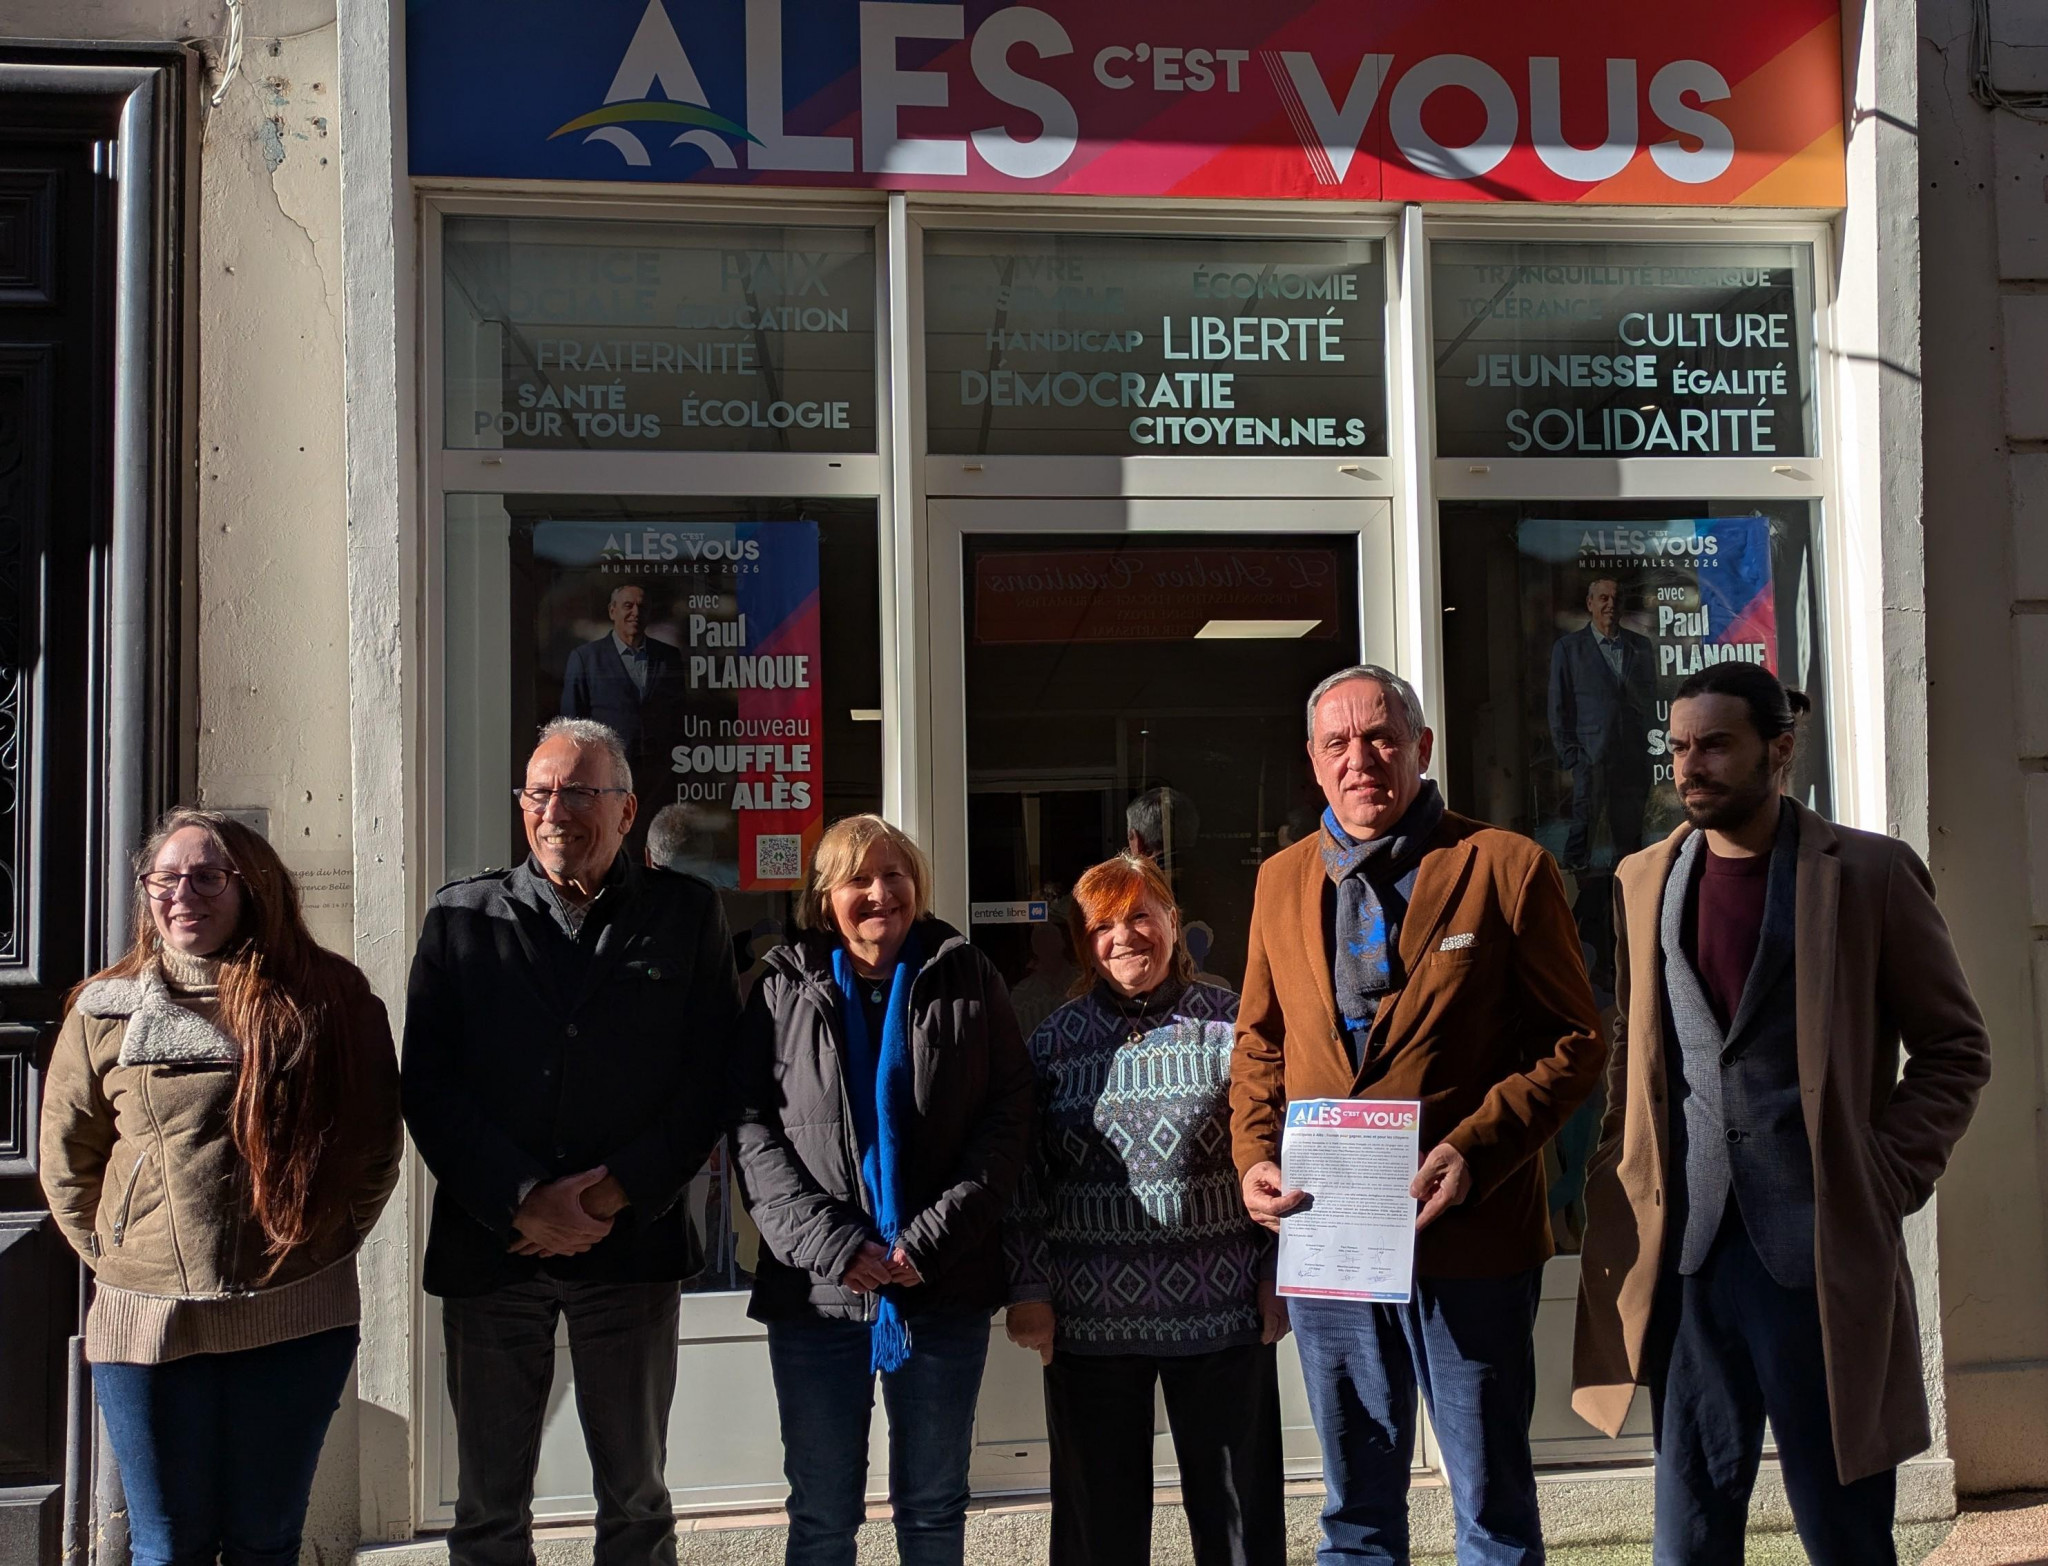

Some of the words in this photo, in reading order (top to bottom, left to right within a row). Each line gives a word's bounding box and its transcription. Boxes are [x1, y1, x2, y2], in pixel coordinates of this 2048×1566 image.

[1093, 44, 1250, 92] C'EST
[1259, 50, 1735, 184] VOUS
[722, 250, 830, 297] PAIX
[1192, 264, 1358, 301] ÉCONOMIE
[676, 296, 849, 332] ÉDUCATION
[1618, 312, 1789, 348] CULTURE
[986, 328, 1144, 352] HANDICAP
[1163, 306, 1345, 362] LIBERTÉ
[537, 334, 757, 376] FRATERNITÉ
[1465, 354, 1658, 387] JEUNESSE
[961, 359, 1235, 408] DÉMOCRATIE
[1672, 360, 1787, 394] ÉGALITÉ
[518, 378, 627, 410] SANTÉ
[682, 390, 851, 429] ÉCOLOGIE
[474, 411, 563, 437] POUR
[573, 413, 661, 438] TOUS
[1129, 416, 1366, 446] CITOYEN.NE.S
[1506, 397, 1776, 452] SOLIDARITÉ
[601, 527, 678, 561] ALÈS
[681, 532, 705, 540] C'EST
[685, 539, 760, 561] VOUS
[1579, 525, 1648, 556] ALÈS
[1652, 535, 1719, 556] VOUS
[601, 564, 710, 574] MUNICIPALES
[721, 564, 760, 574] 2026
[1579, 558, 1675, 568] MUNICIPALES
[1684, 558, 1719, 568] 2026
[688, 593, 719, 609] avec
[1657, 587, 1685, 601] avec
[689, 612, 746, 647] Paul
[1659, 604, 1709, 637] Paul
[690, 655, 809, 690] PLANQUE
[684, 715, 711, 737] Un
[719, 718, 809, 737] nouveau
[671, 744, 811, 774] SOUFFLE
[677, 782, 727, 805] pour
[731, 773, 812, 810] ALÈS
[974, 907, 1003, 918] entrée
[1007, 907, 1026, 917] libre
[1293, 1102, 1341, 1126] ALÈS
[1363, 1112, 1413, 1127] VOUS
